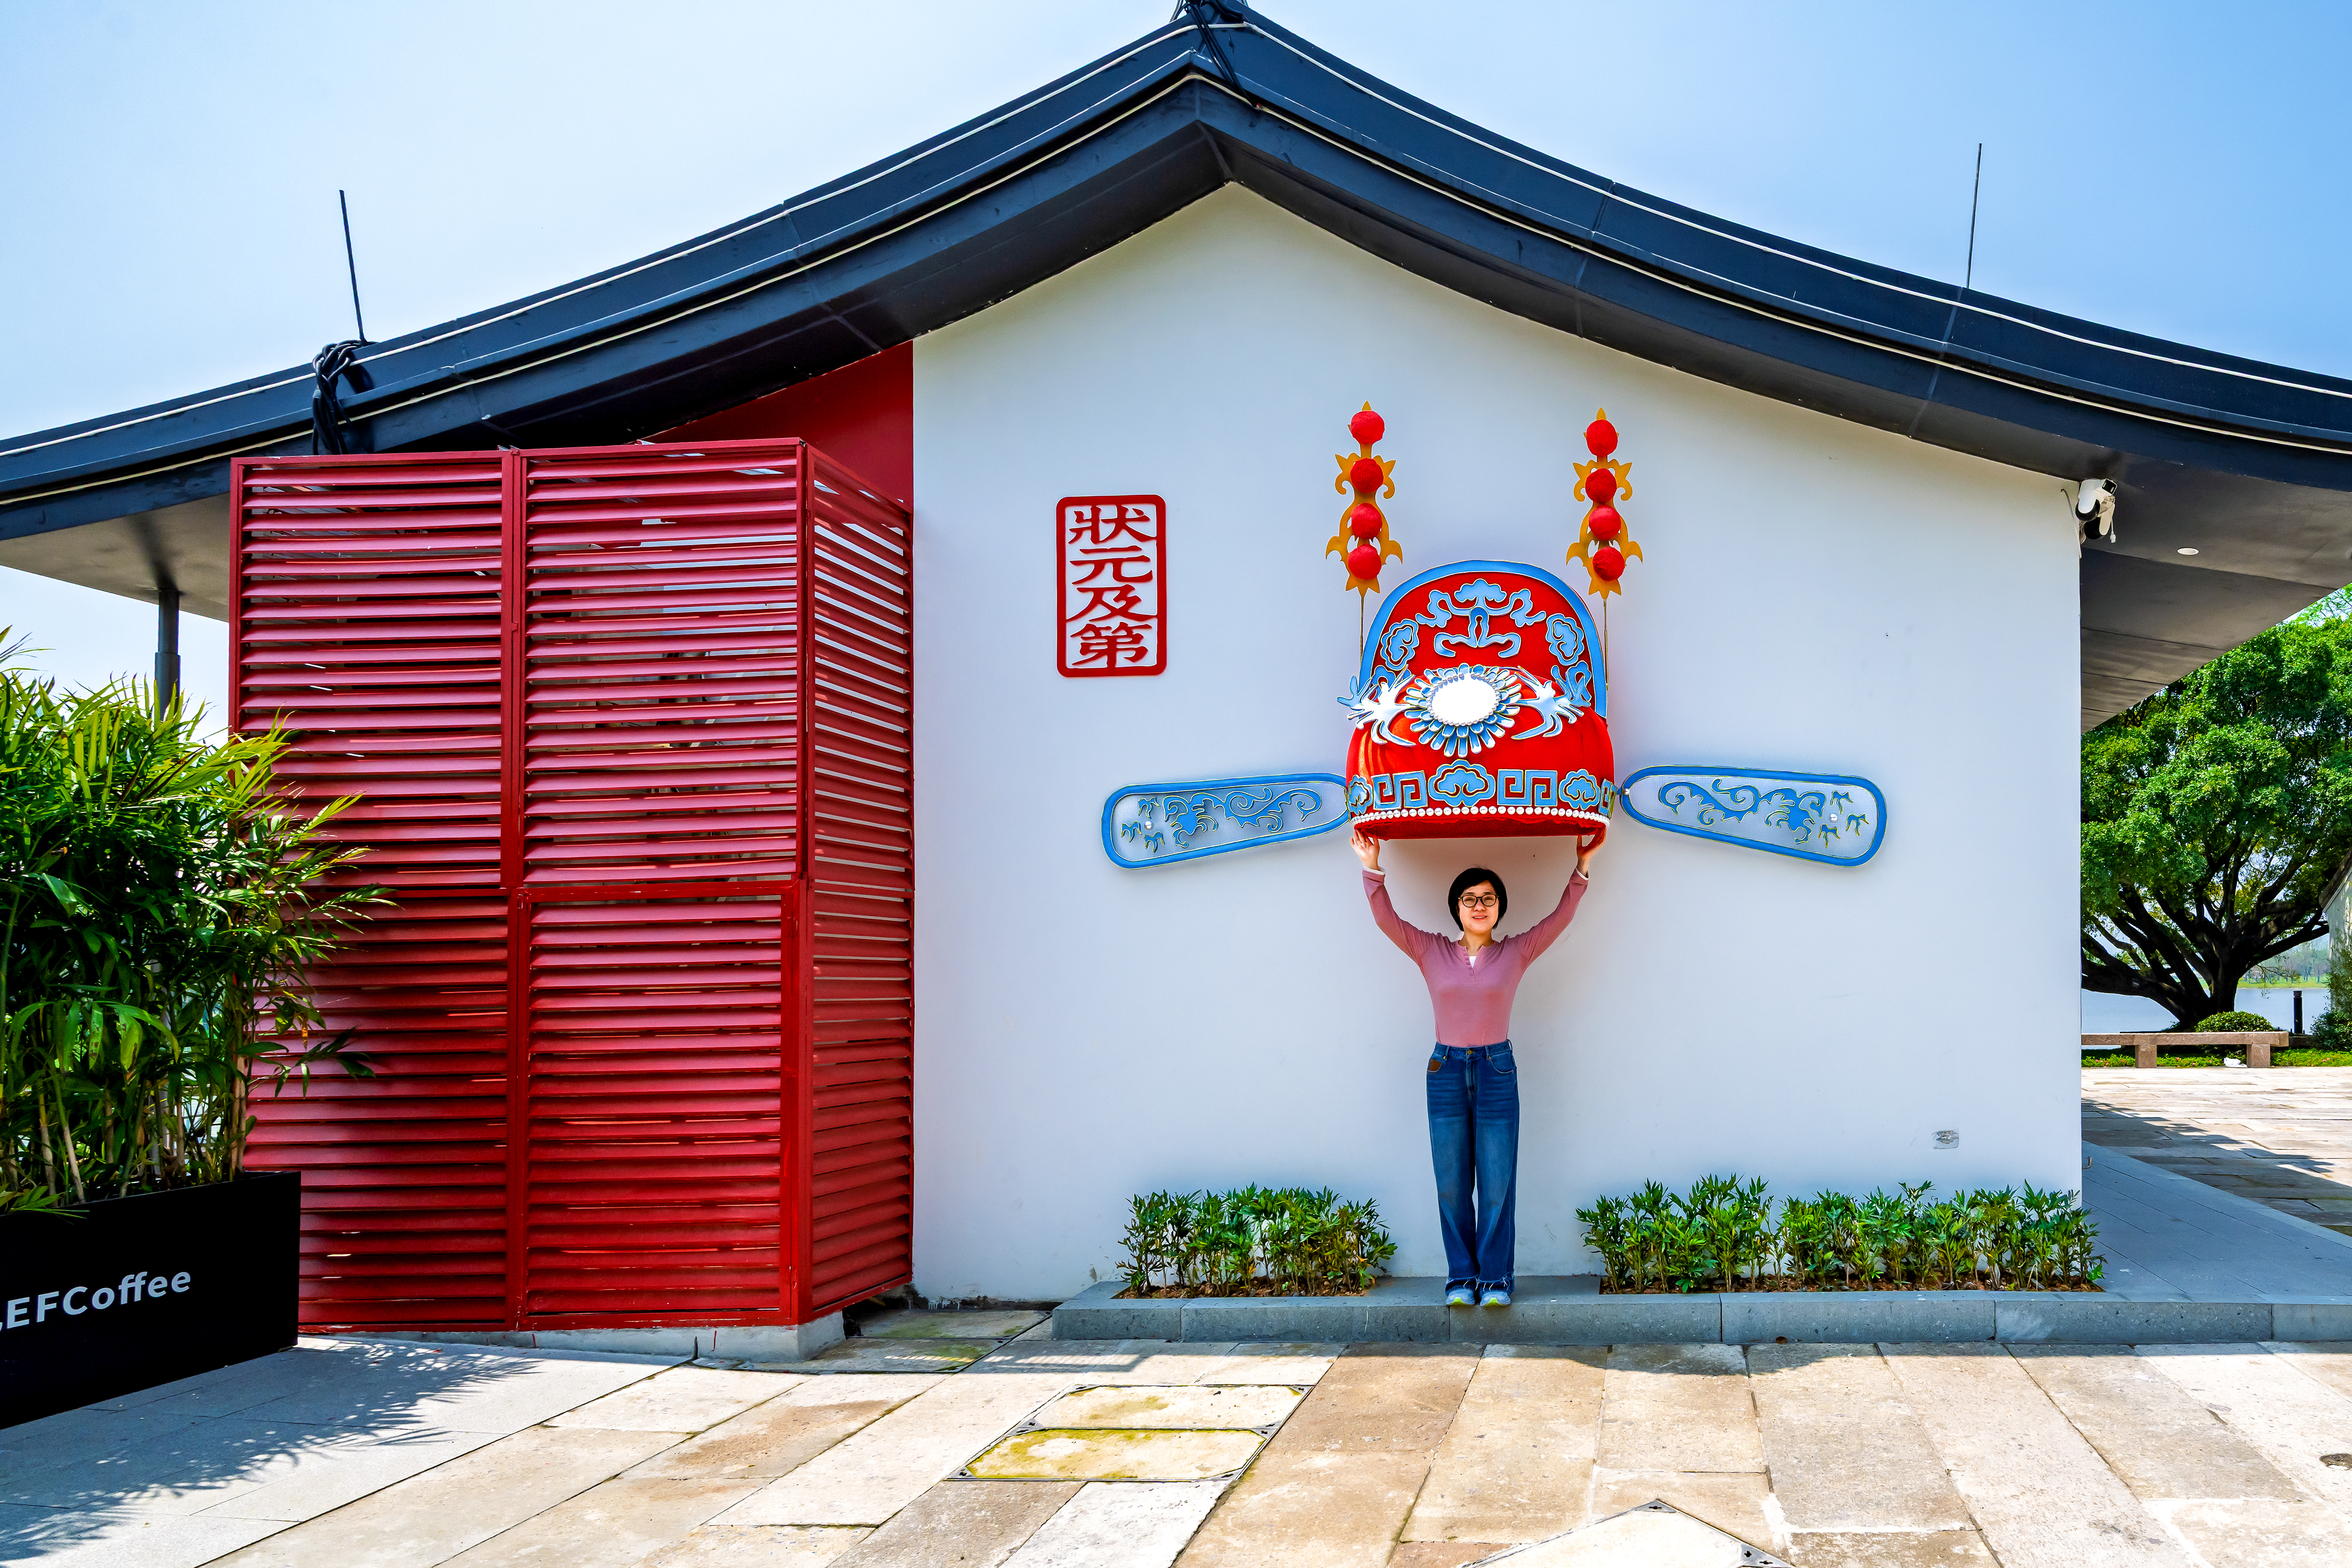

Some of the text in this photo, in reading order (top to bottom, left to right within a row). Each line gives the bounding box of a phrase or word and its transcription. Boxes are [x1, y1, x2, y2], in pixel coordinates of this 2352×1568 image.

[1064, 504, 1157, 668] 狀元及第
[0, 1271, 191, 1331] EFCoffee
